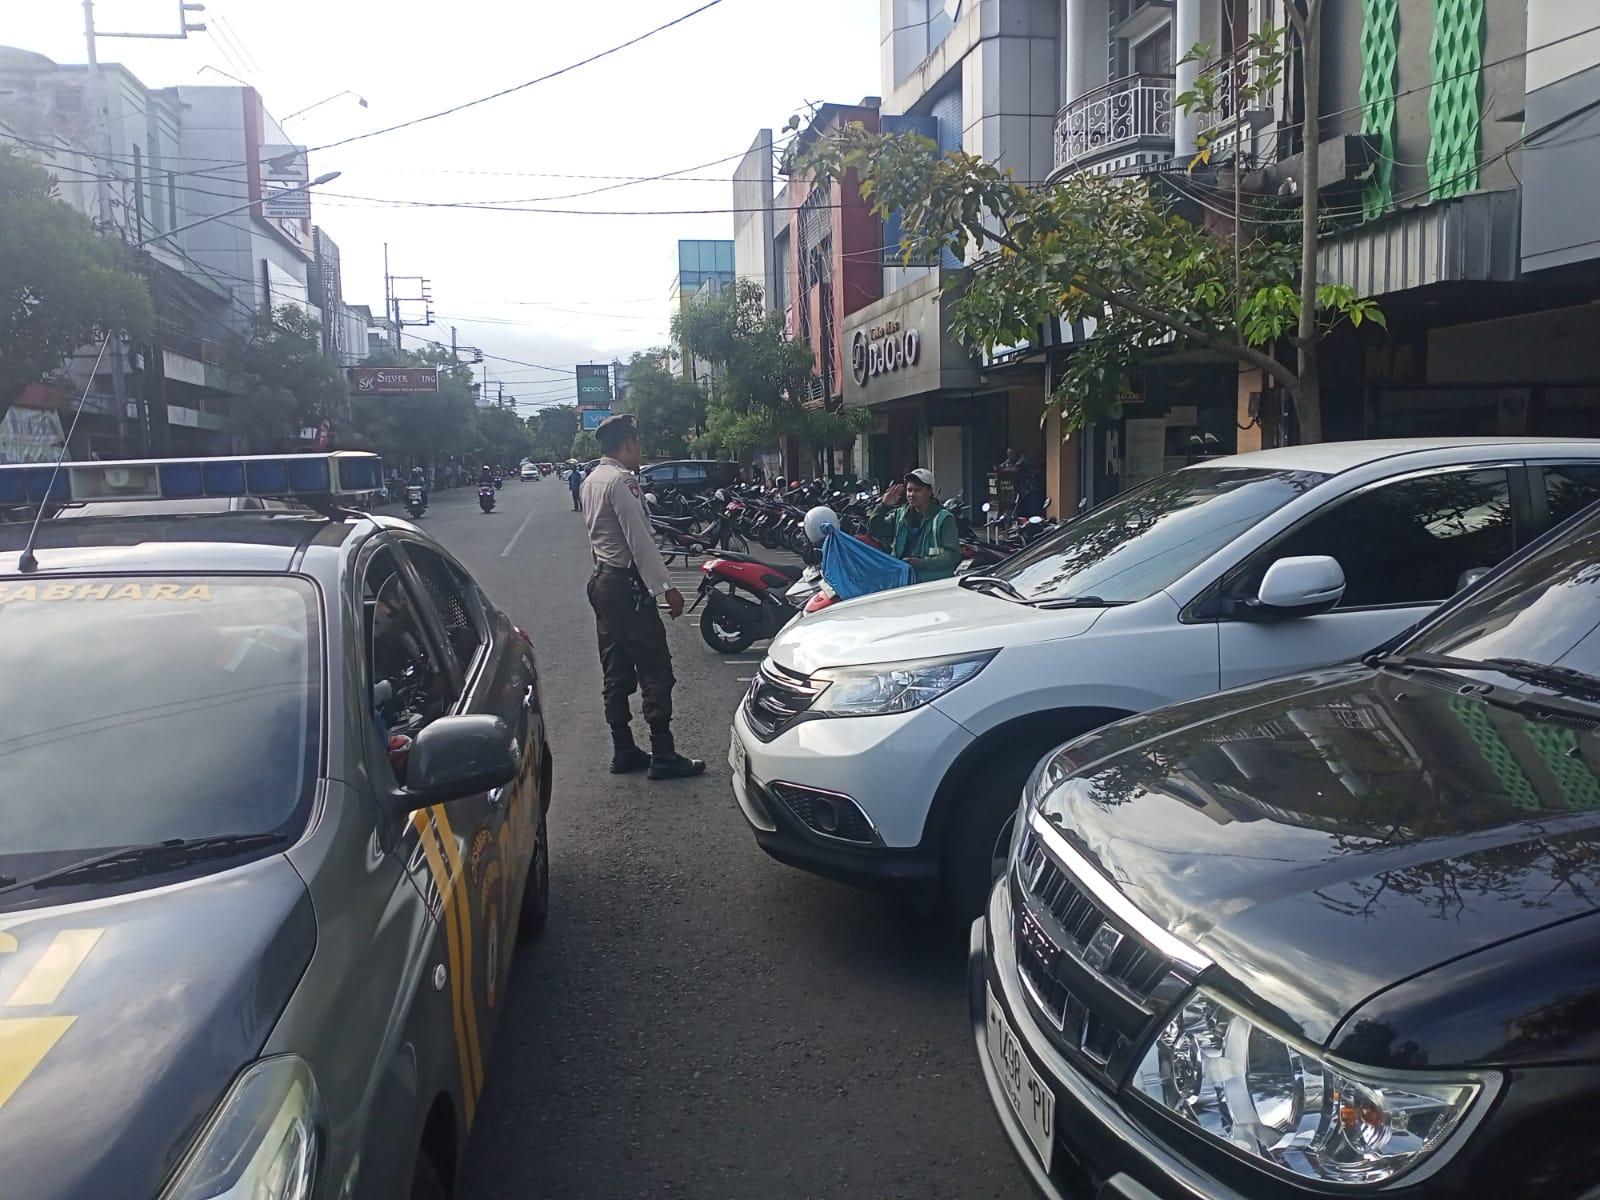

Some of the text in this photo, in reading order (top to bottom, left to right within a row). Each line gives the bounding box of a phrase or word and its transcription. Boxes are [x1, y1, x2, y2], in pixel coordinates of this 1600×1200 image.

[868, 328, 920, 376] DJOJO
[998, 1017, 1050, 1137] 1498 PU
